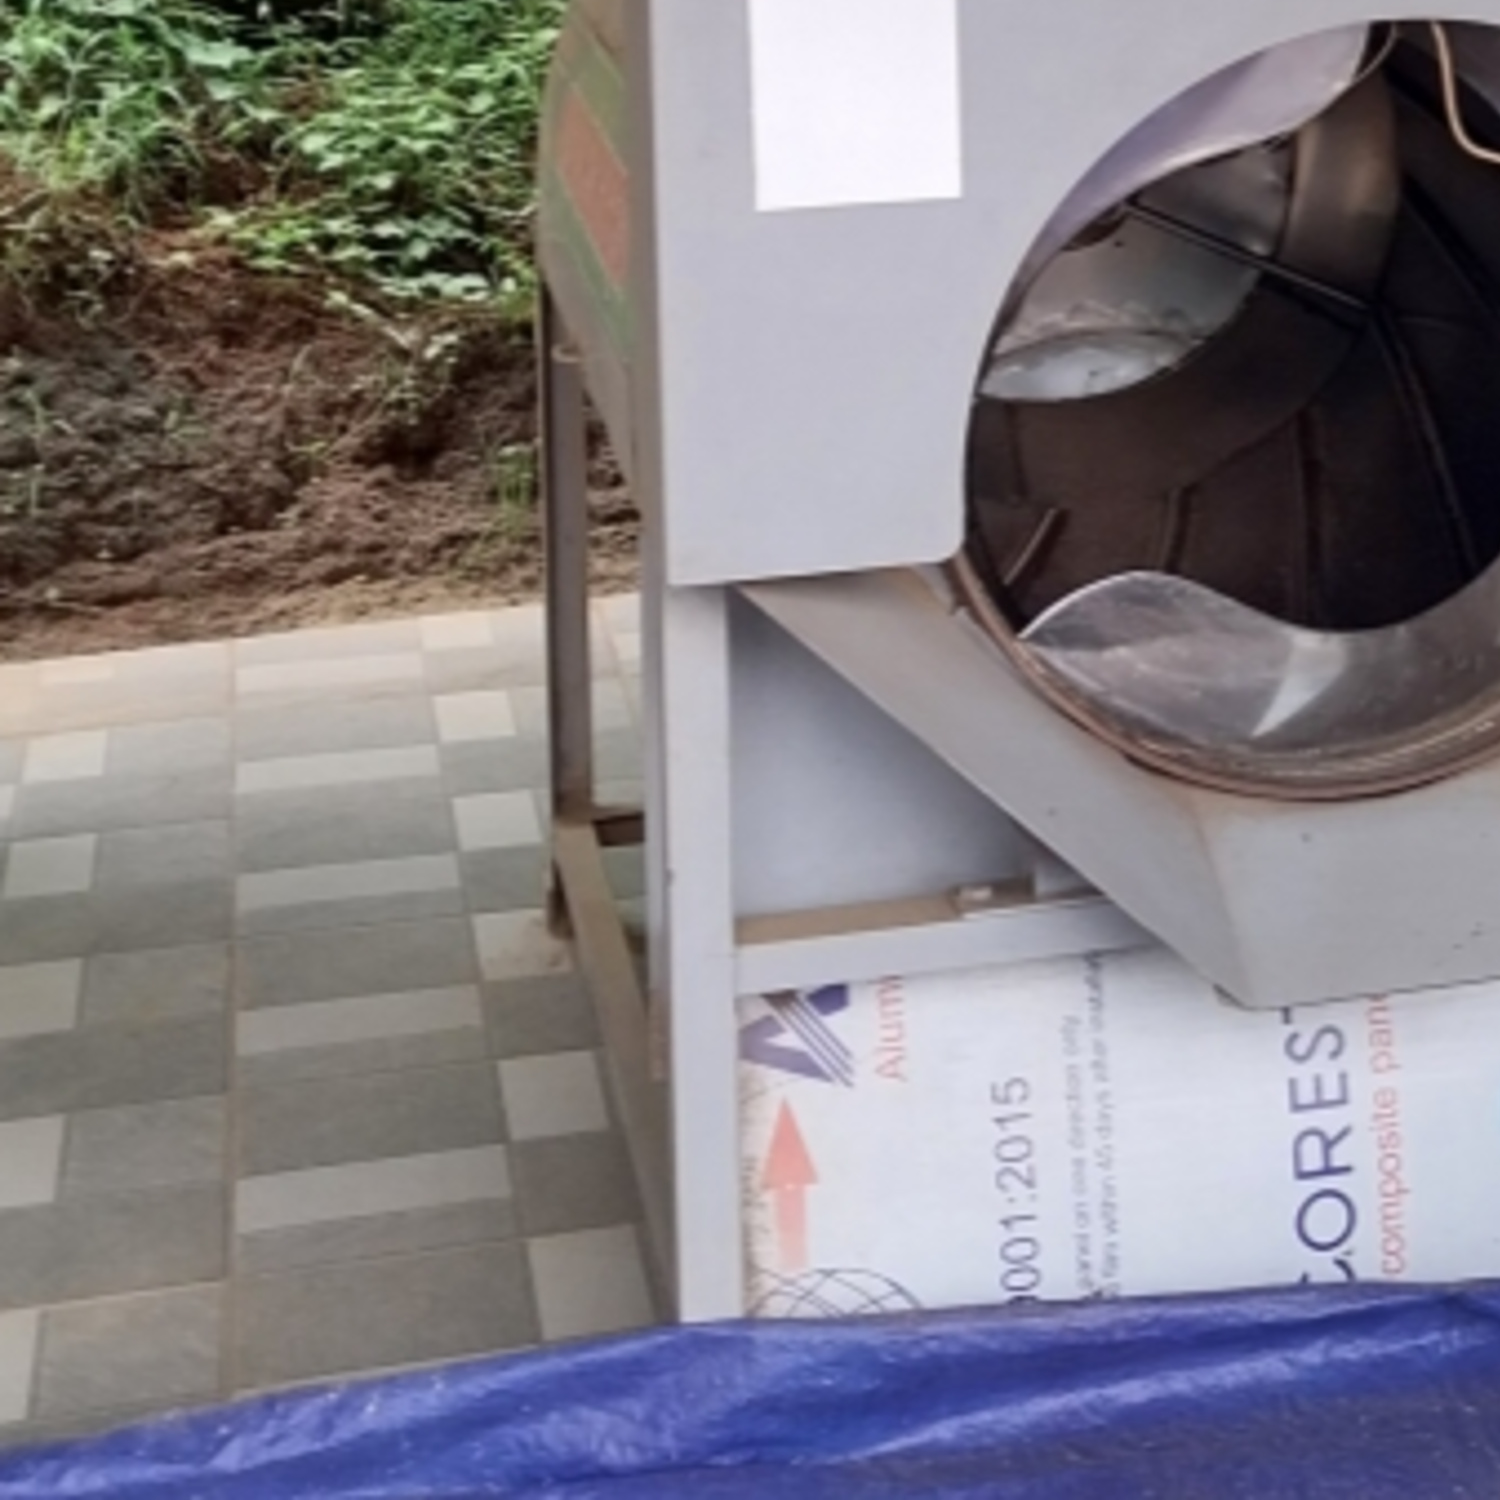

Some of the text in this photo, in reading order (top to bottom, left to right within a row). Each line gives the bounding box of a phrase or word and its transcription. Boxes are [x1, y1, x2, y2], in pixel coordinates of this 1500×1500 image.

[989, 1076, 1041, 1302] 001:2015
[1365, 994, 1411, 1278] composite pan
